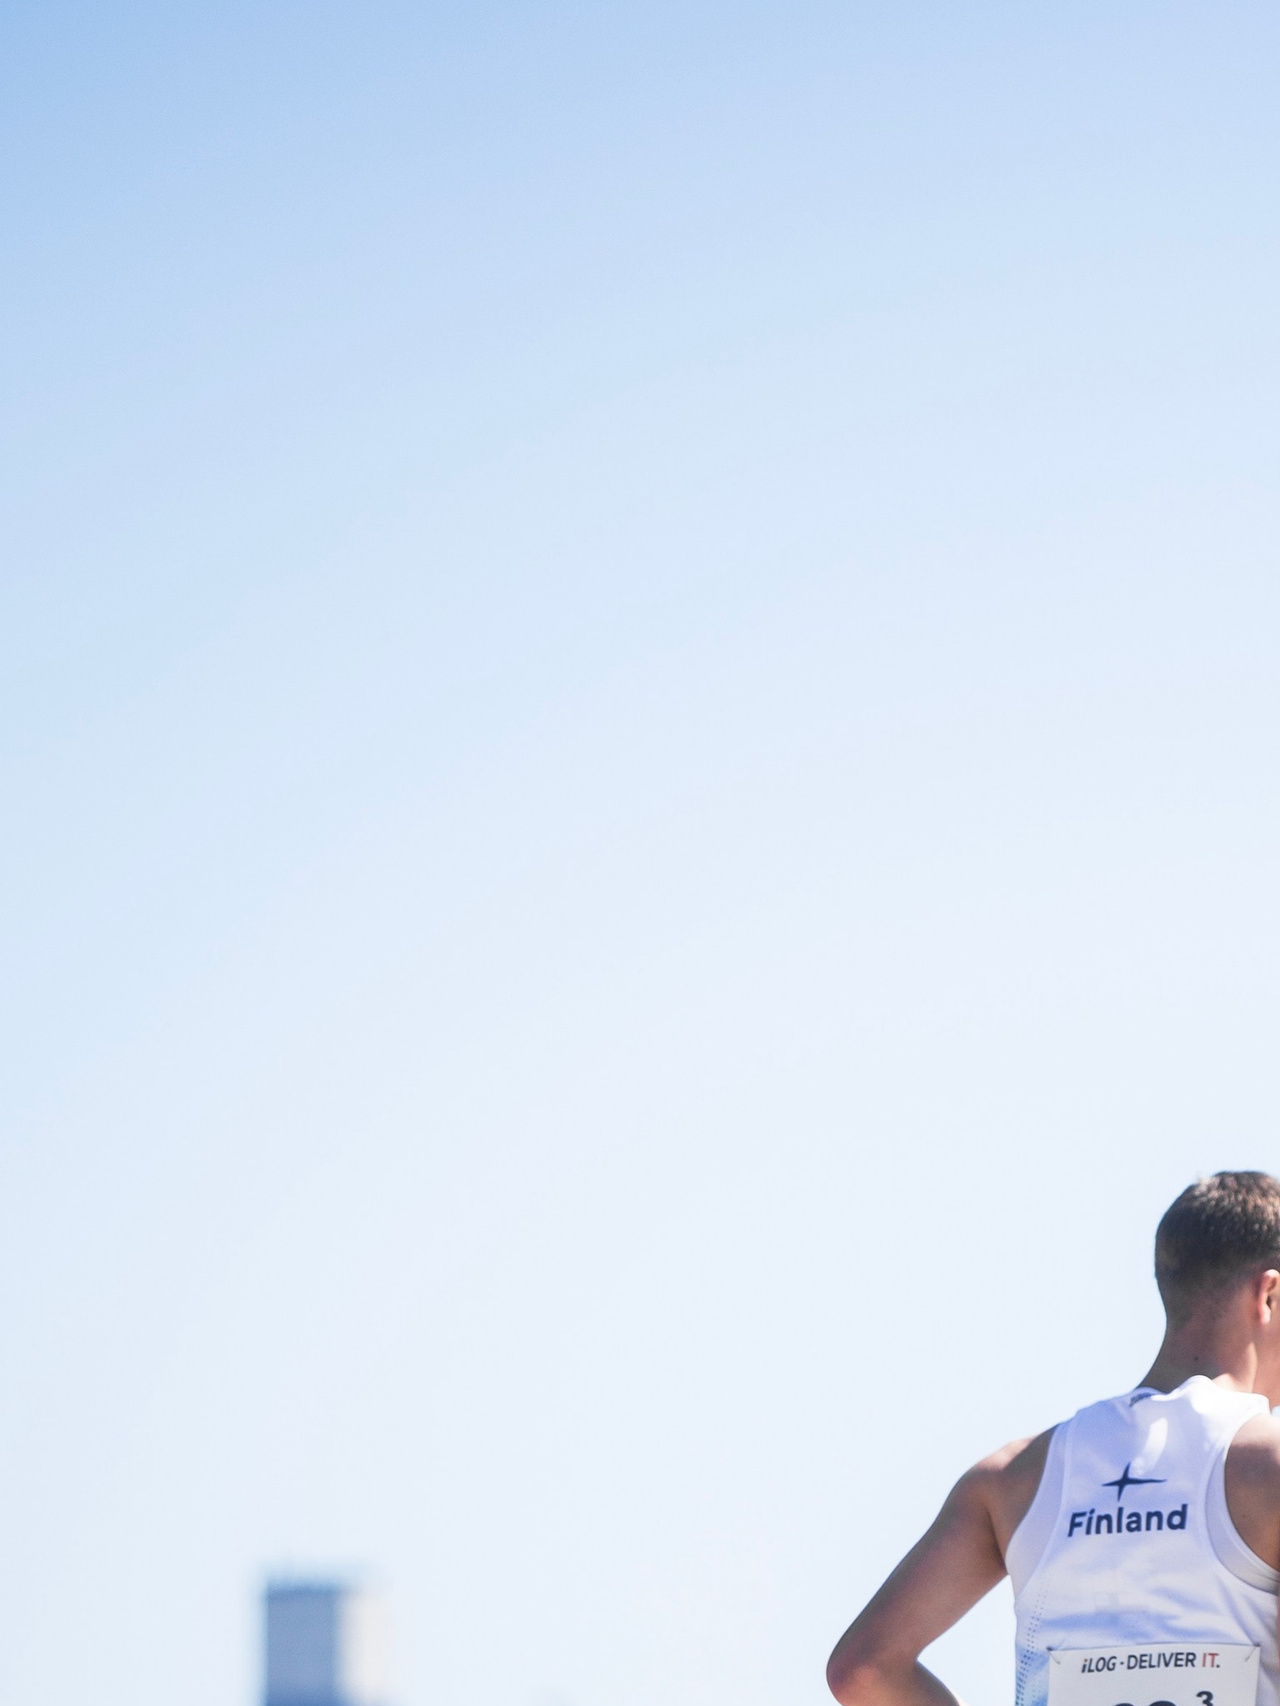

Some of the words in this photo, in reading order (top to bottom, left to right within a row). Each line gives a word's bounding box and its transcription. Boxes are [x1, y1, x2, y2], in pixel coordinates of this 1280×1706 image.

[1068, 1504, 1188, 1537] Finland
[1081, 1656, 1118, 1673] iLOG
[1127, 1652, 1197, 1670] DELIVER
[1202, 1653, 1220, 1668] IT.
